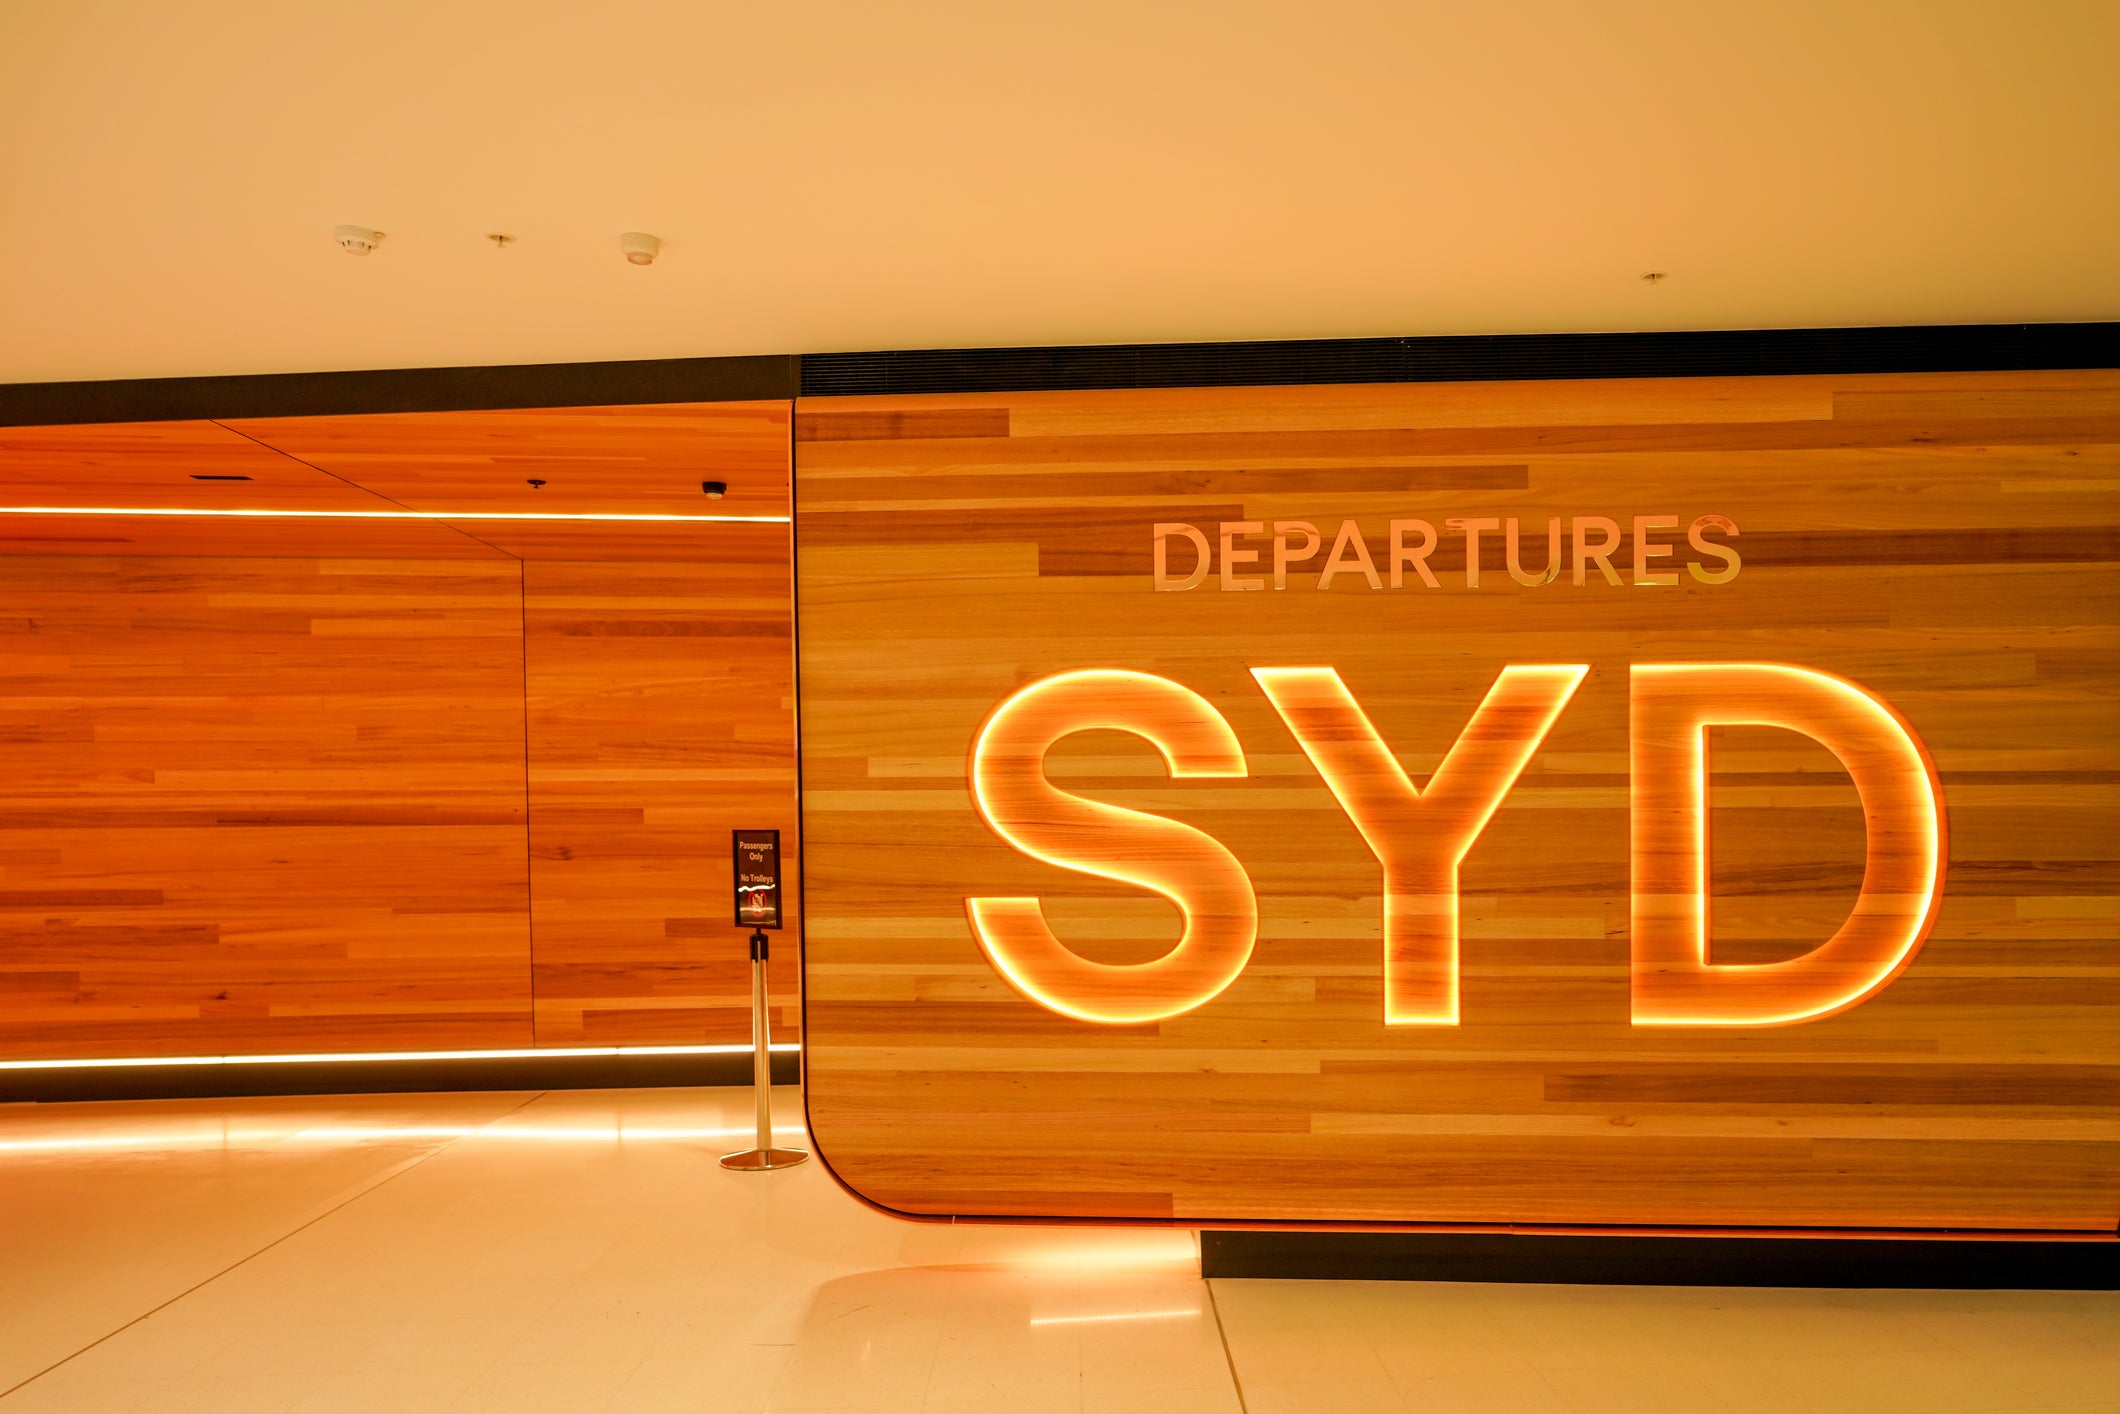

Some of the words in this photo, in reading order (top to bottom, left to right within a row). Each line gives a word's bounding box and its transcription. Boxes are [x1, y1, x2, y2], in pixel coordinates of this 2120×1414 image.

[1153, 514, 1742, 592] DEPARTURES
[740, 841, 773, 851] Passengers
[965, 661, 1948, 1028] SYD
[749, 852, 763, 862] Only
[741, 874, 749, 882] No
[750, 874, 774, 884] Trolleys
